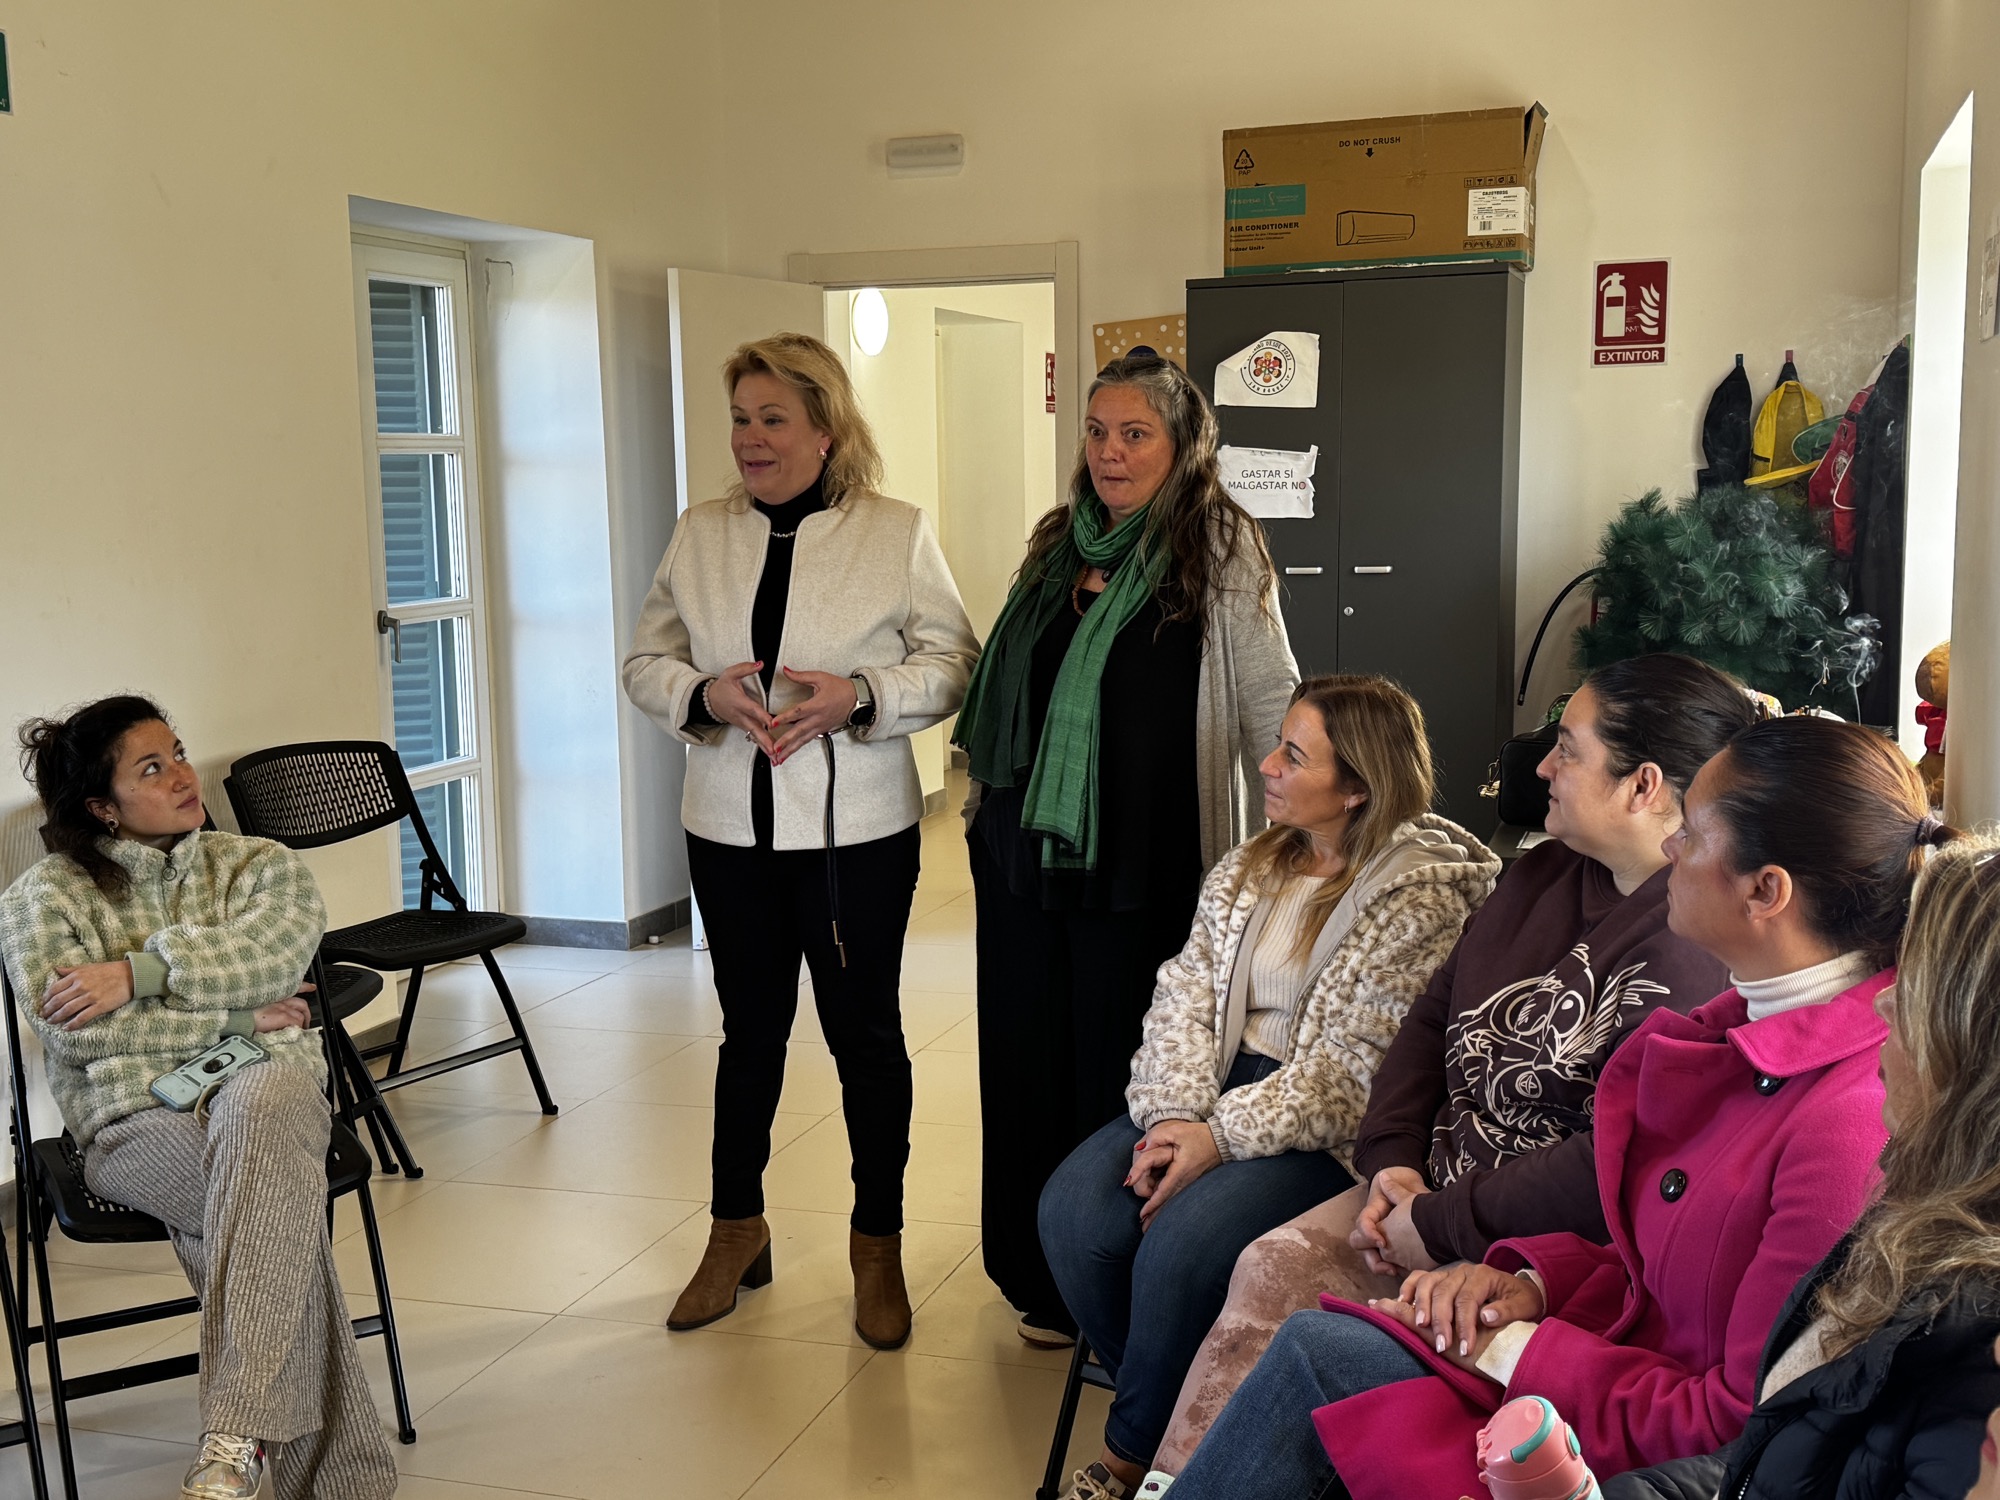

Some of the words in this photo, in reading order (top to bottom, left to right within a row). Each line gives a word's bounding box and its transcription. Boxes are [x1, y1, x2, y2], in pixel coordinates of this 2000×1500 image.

[1338, 140, 1351, 148] DO
[1353, 138, 1370, 147] NOT
[1372, 136, 1401, 145] CRUSH
[1229, 225, 1243, 233] AIR
[1245, 221, 1300, 232] CONDITIONER
[1599, 349, 1660, 363] EXTINTOR
[1241, 469, 1281, 479] GASTAR
[1284, 467, 1294, 479] SÍ
[1228, 480, 1288, 490] MALGASTAR
[1291, 481, 1307, 490] NO
